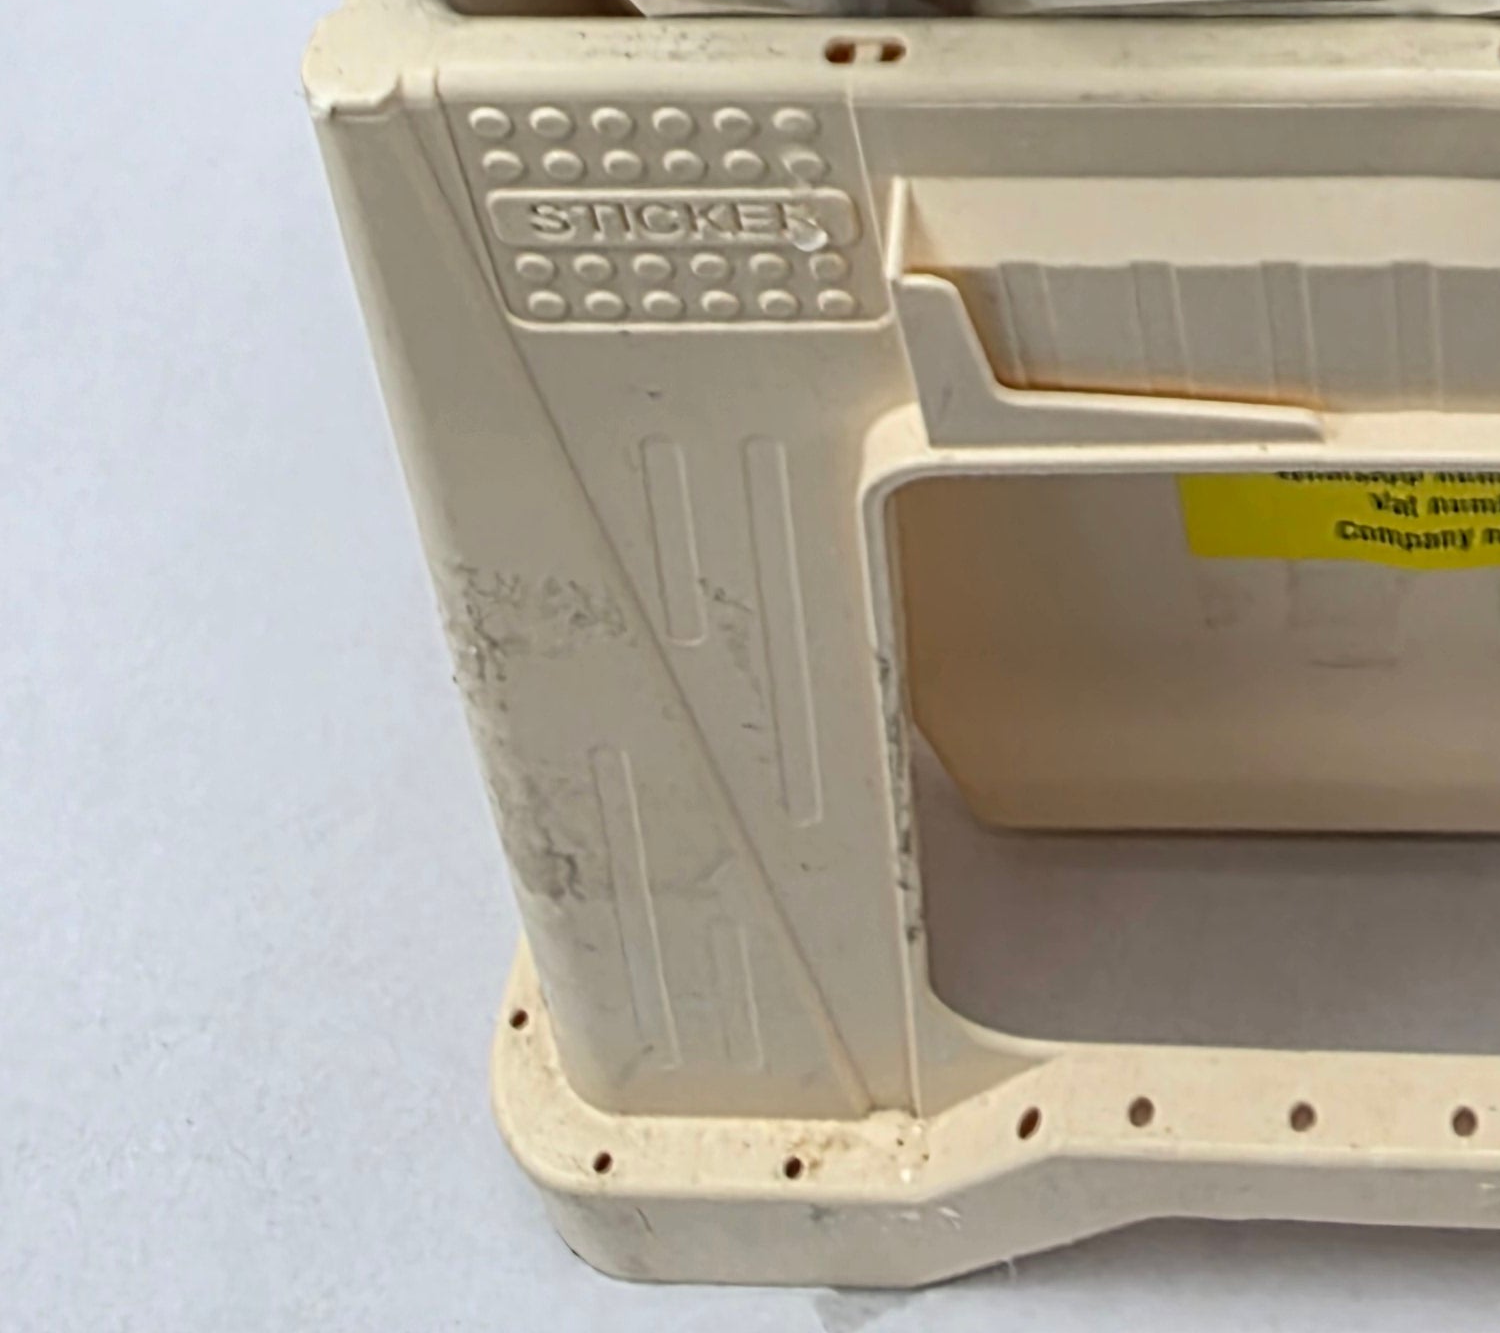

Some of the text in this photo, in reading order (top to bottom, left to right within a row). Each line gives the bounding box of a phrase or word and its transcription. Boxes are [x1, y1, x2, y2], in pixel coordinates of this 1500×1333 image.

[529, 201, 822, 242] STICKER
[1368, 492, 1419, 518] Vat
[1334, 519, 1475, 551] Company
